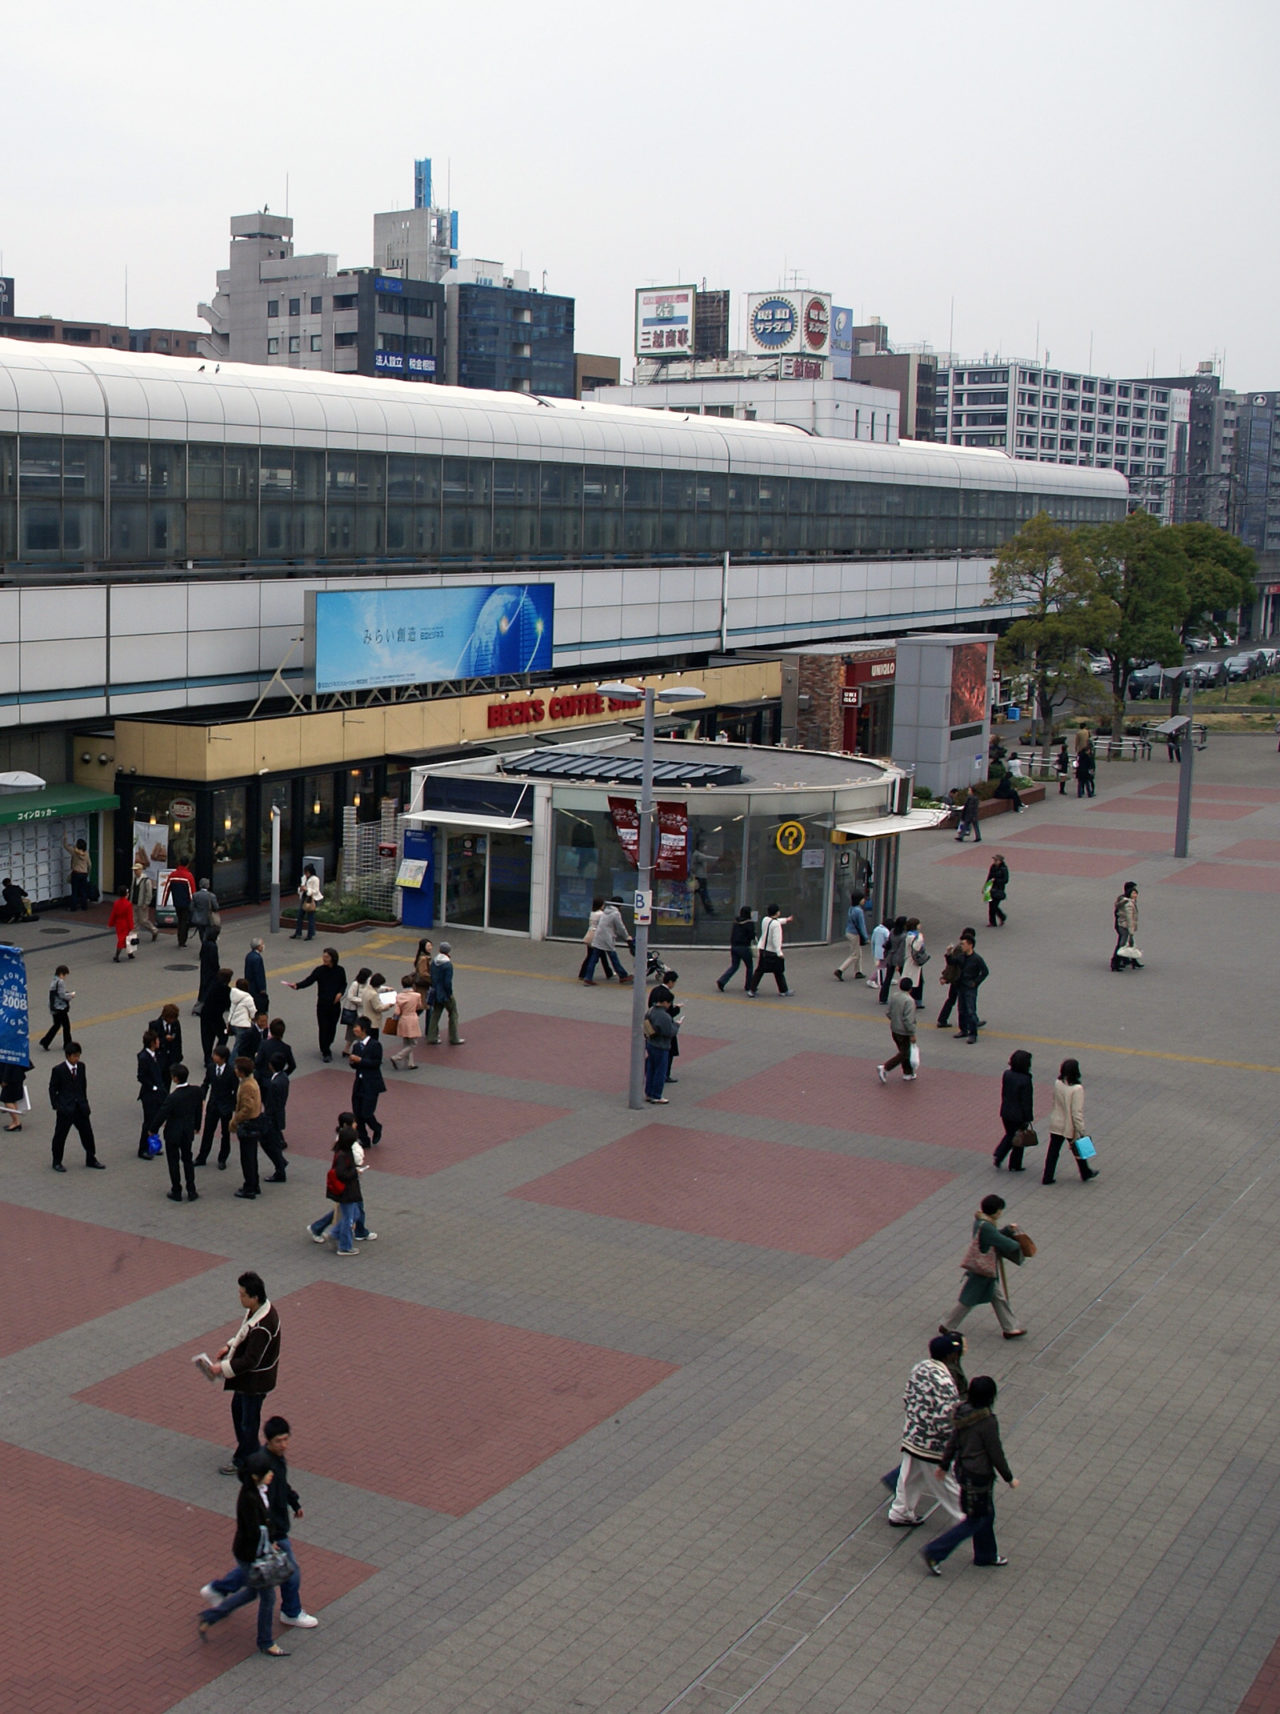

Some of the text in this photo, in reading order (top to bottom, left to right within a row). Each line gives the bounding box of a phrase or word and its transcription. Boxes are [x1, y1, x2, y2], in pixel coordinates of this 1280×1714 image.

[872, 662, 895, 677] UNIQLO
[549, 693, 605, 719] COFFEE
[17, 808, 58, 821] コインロッカー
[635, 894, 645, 908] B
[2, 995, 28, 1010] 2008
